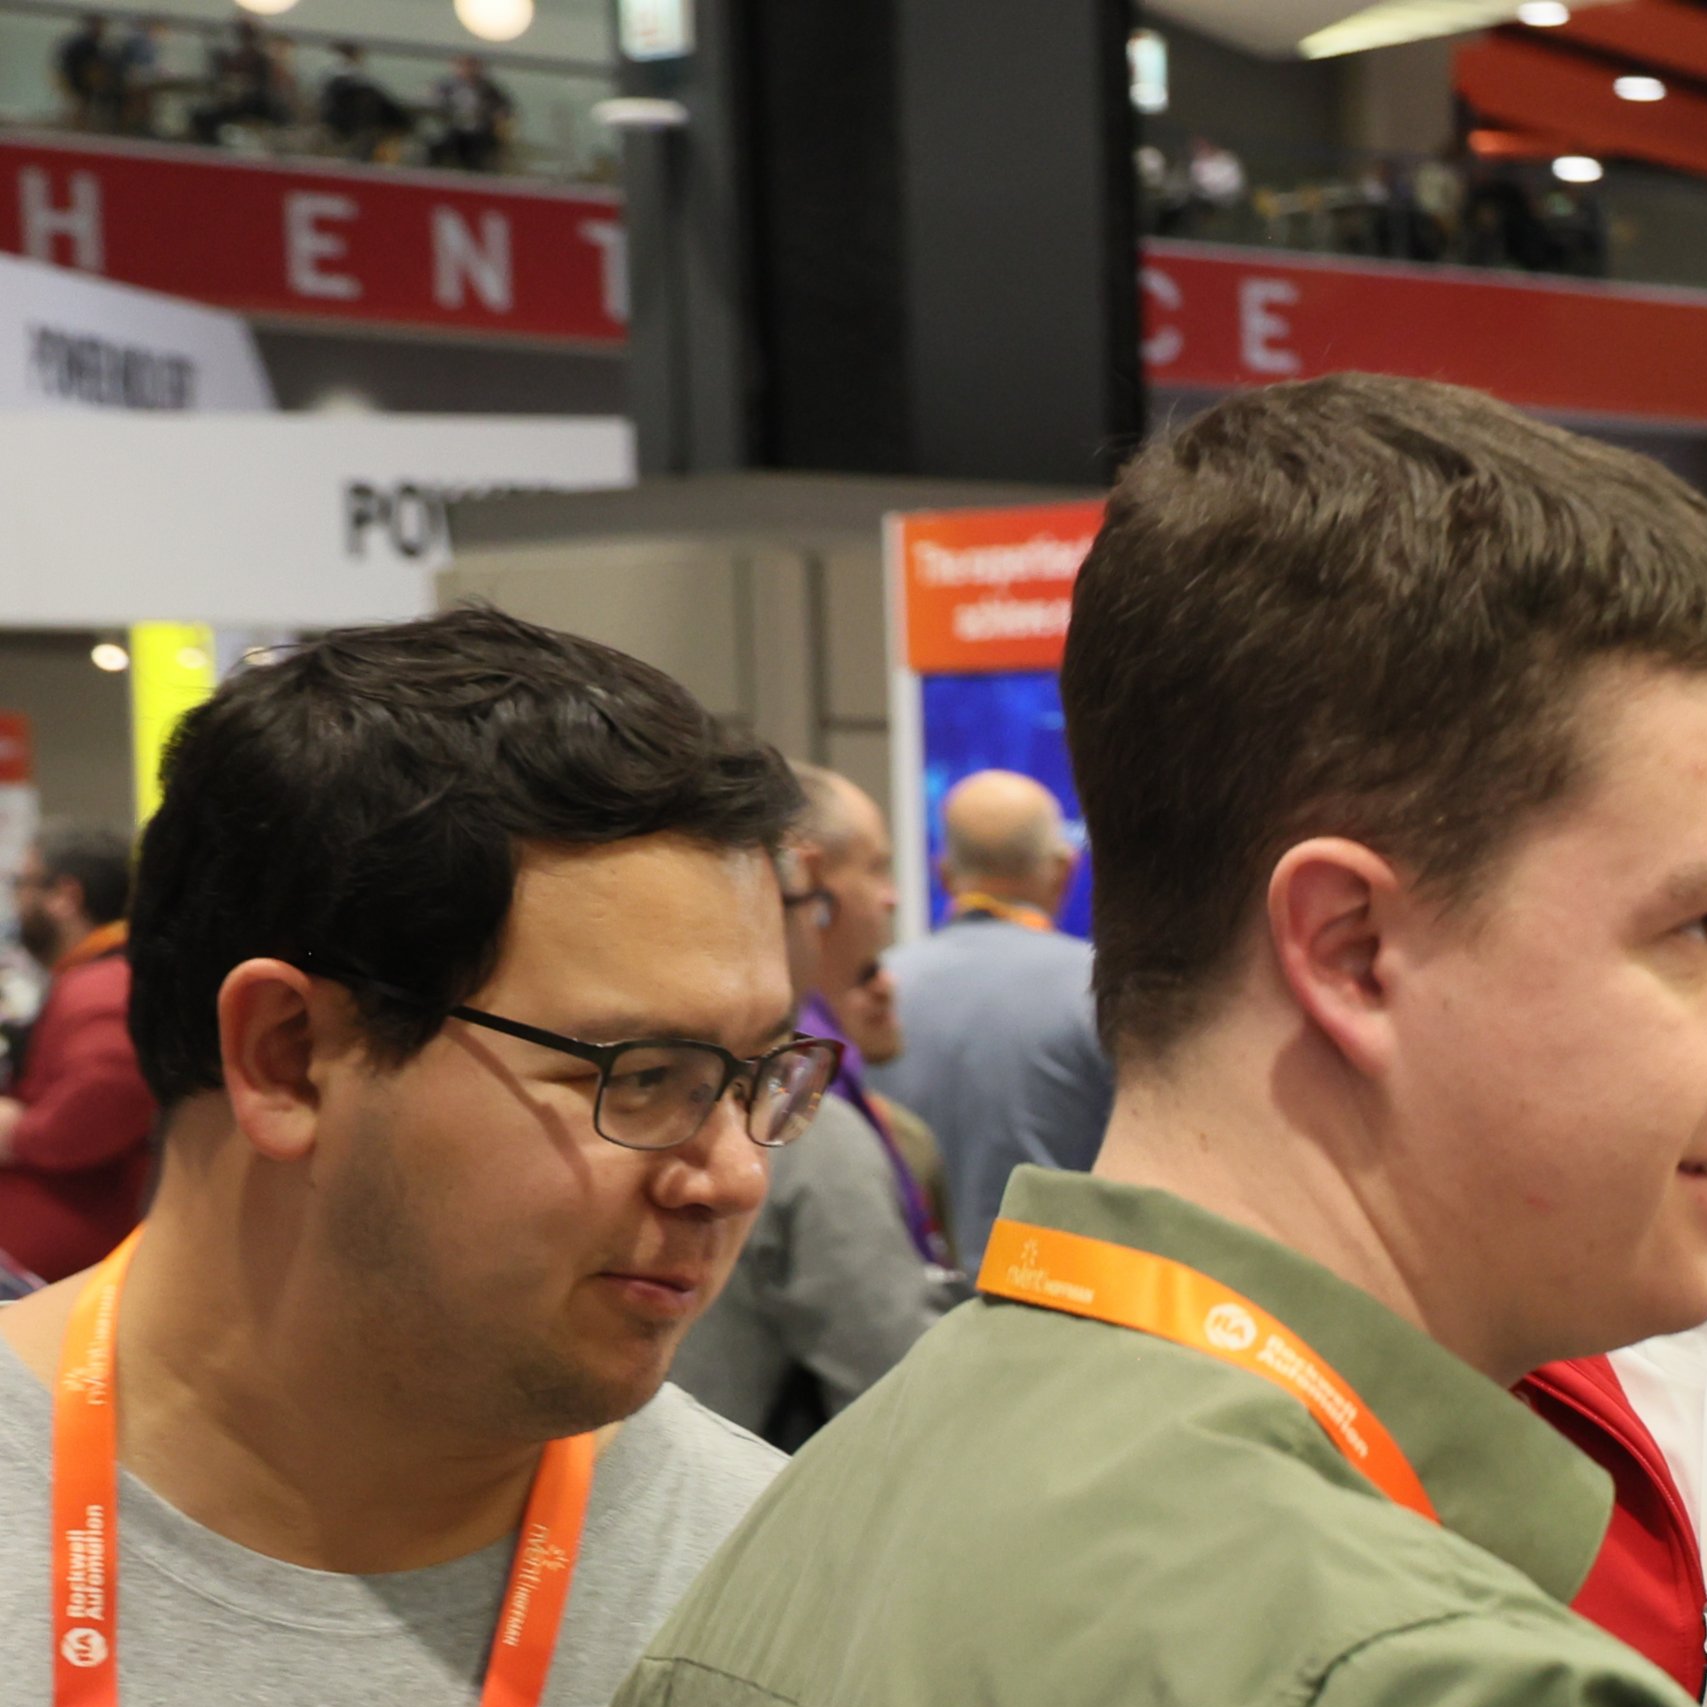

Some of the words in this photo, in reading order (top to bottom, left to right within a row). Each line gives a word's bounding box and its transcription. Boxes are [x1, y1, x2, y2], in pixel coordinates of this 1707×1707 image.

[1256, 1350, 1369, 1458] Automation
[1266, 1334, 1358, 1422] Rockwell
[65, 1529, 87, 1618] Rockwell
[86, 1504, 105, 1621] Automation
